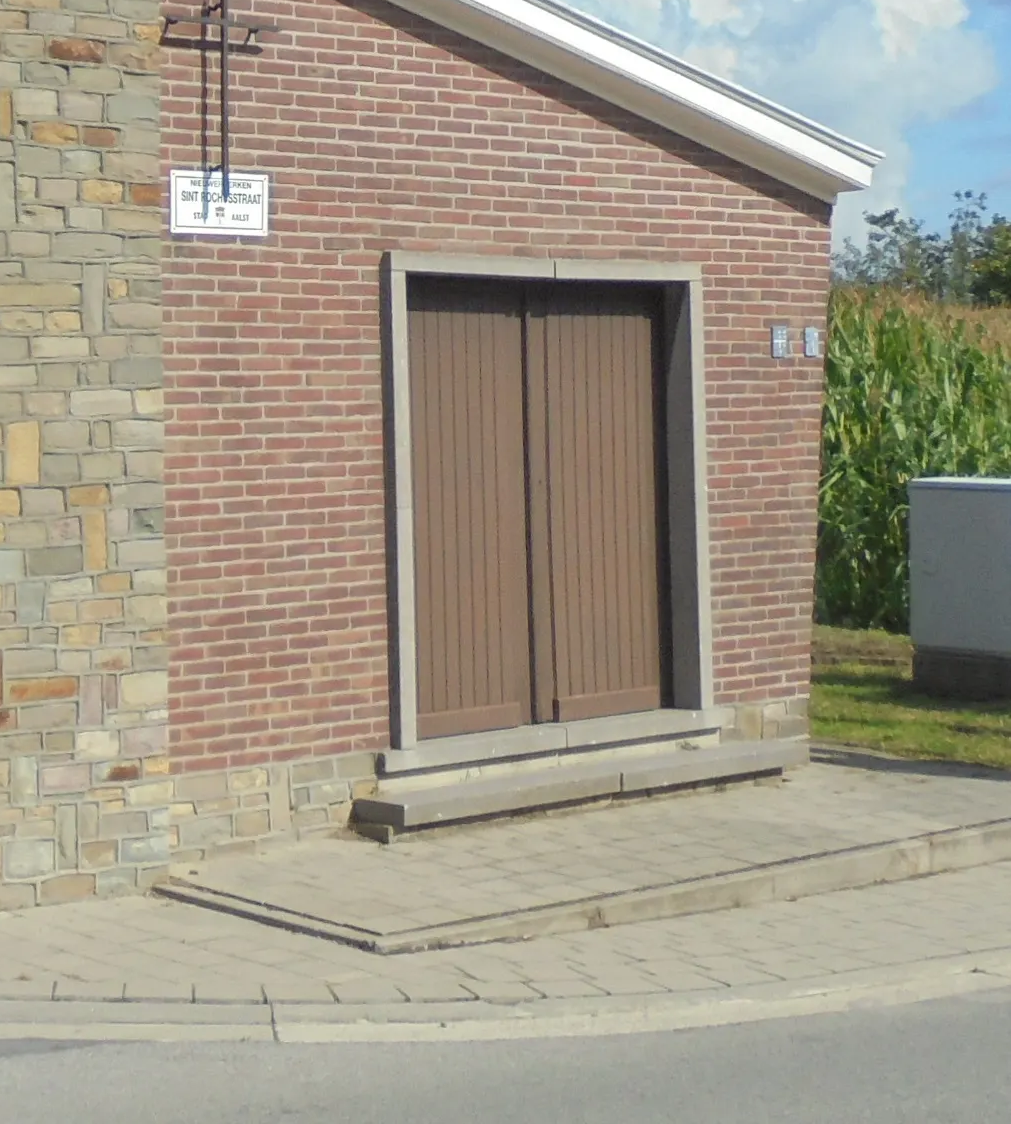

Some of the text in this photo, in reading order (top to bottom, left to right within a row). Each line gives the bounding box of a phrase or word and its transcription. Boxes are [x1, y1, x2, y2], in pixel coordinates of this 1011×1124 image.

[190, 179, 252, 190] NIEUWERERKEN
[181, 190, 261, 205] SINT ROCHSSTRAAT
[193, 212, 249, 222] STA AALST
